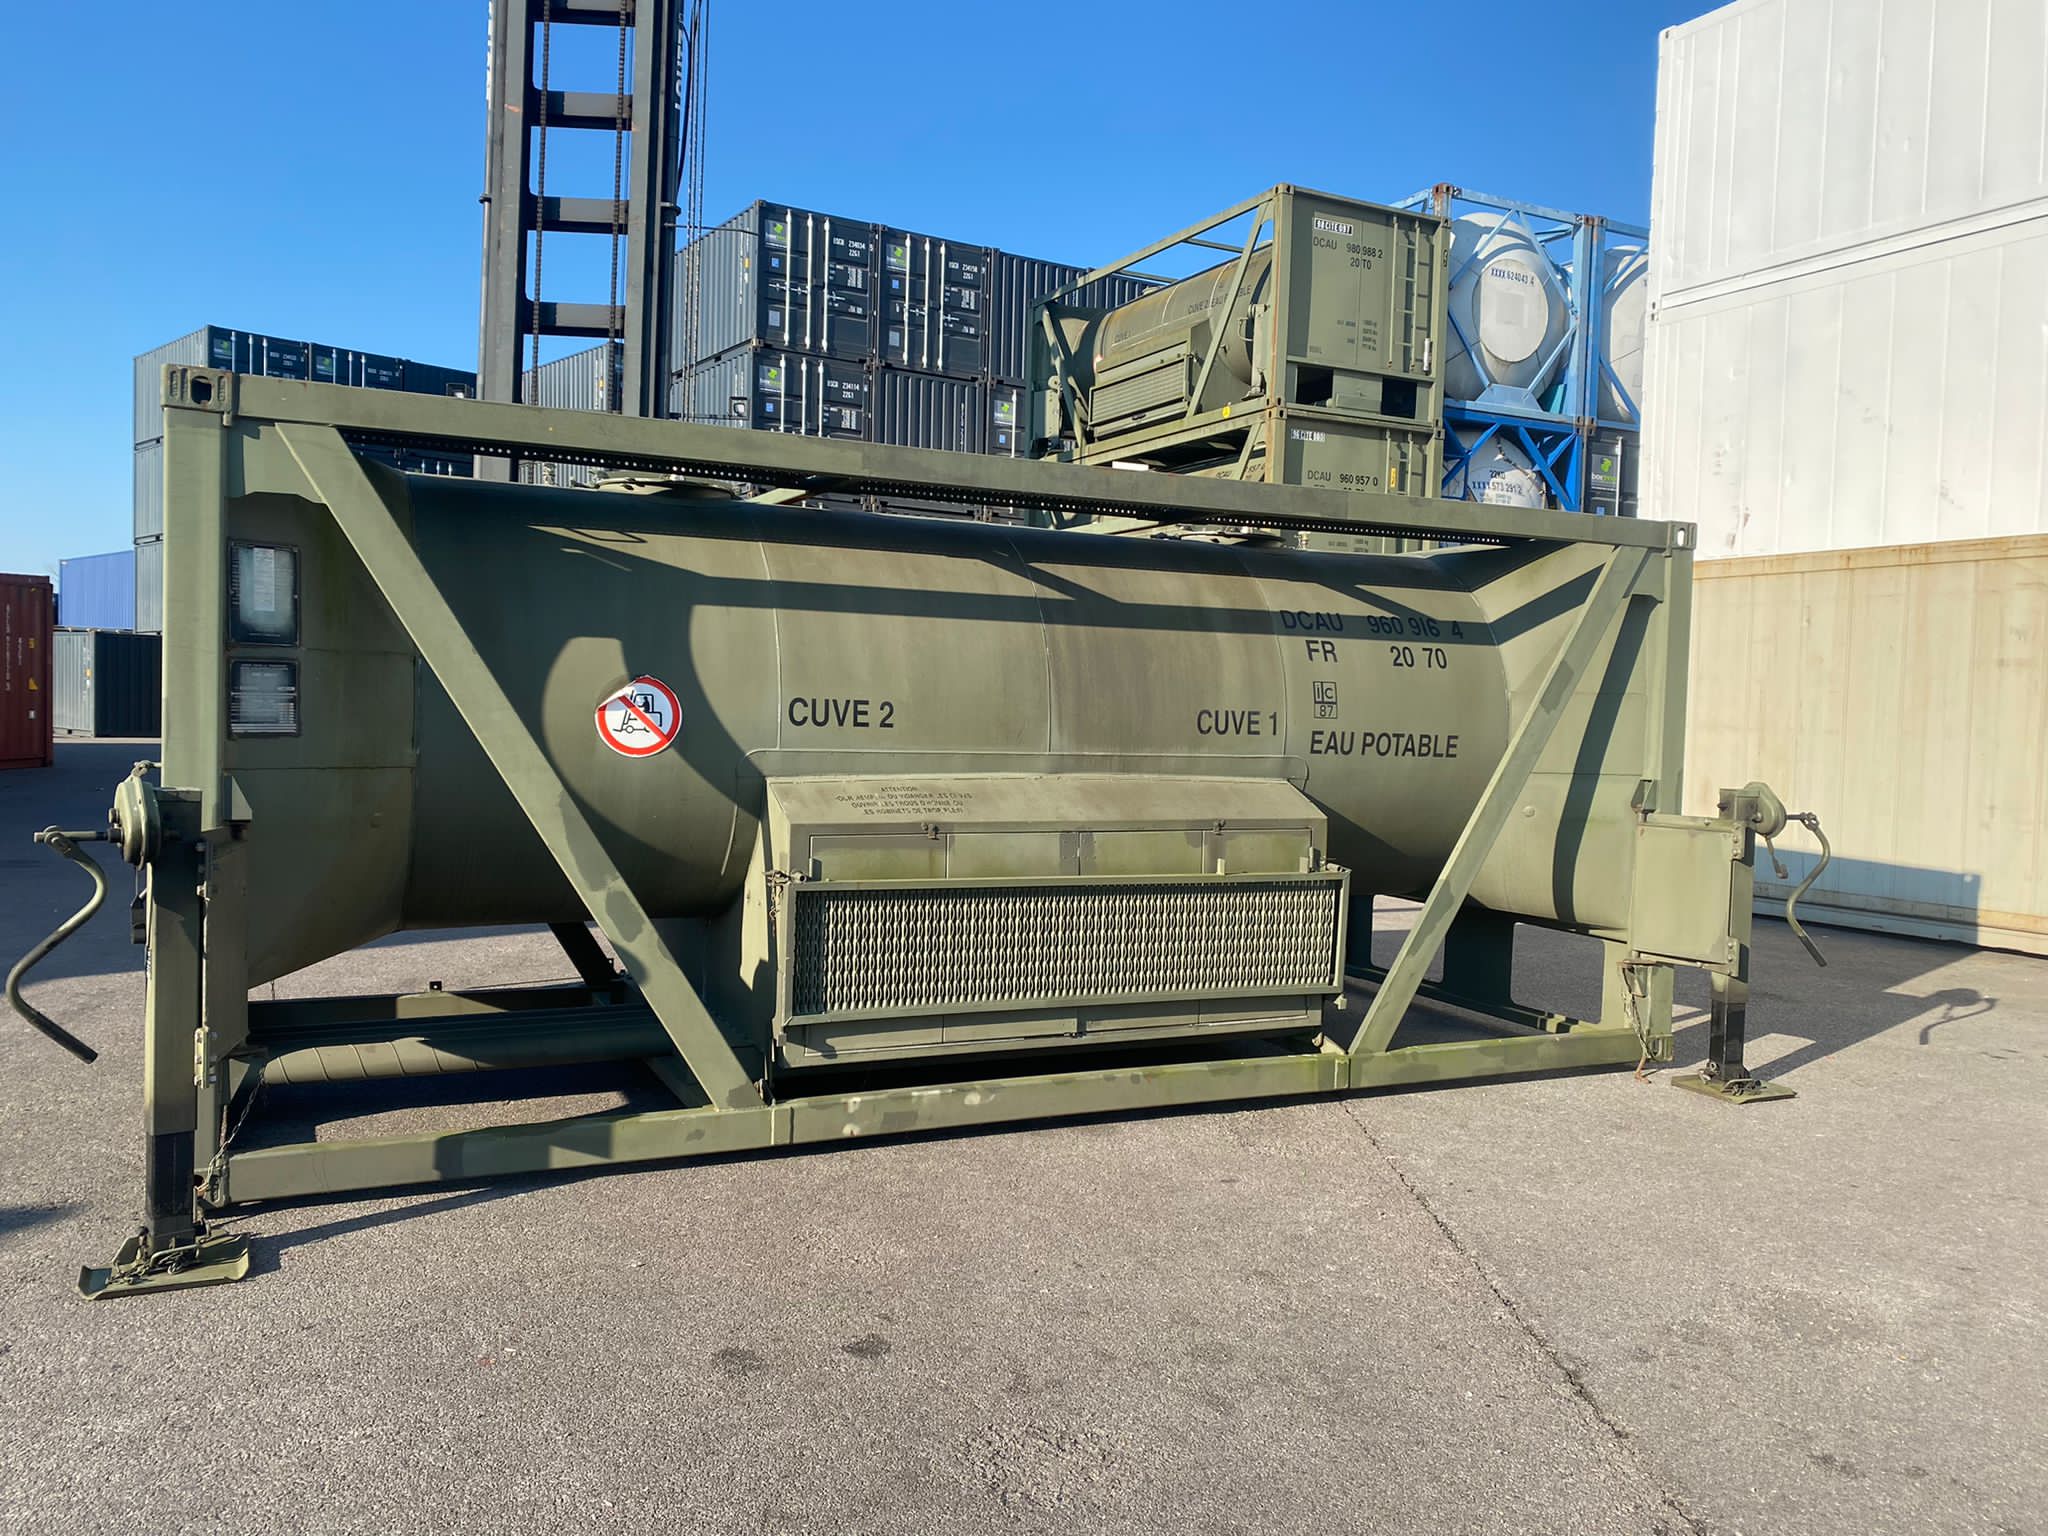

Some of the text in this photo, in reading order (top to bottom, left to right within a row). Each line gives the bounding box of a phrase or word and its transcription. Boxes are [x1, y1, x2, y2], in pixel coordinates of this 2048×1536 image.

[1313, 236, 1338, 250] DCAU
[1377, 249, 1384, 259] 2
[1350, 257, 1361, 268] 20
[1307, 470, 1378, 487] DCAU 960 957 0
[1280, 610, 1464, 640] DCAU 960 916 4
[1305, 640, 1447, 669] FR 20 70
[788, 697, 894, 728] CUVE 2
[1197, 709, 1277, 736] CUVE 1
[1319, 705, 1334, 718] 87
[1309, 730, 1459, 758] EAU POTABLE
[880, 785, 918, 793] ATTENTION
